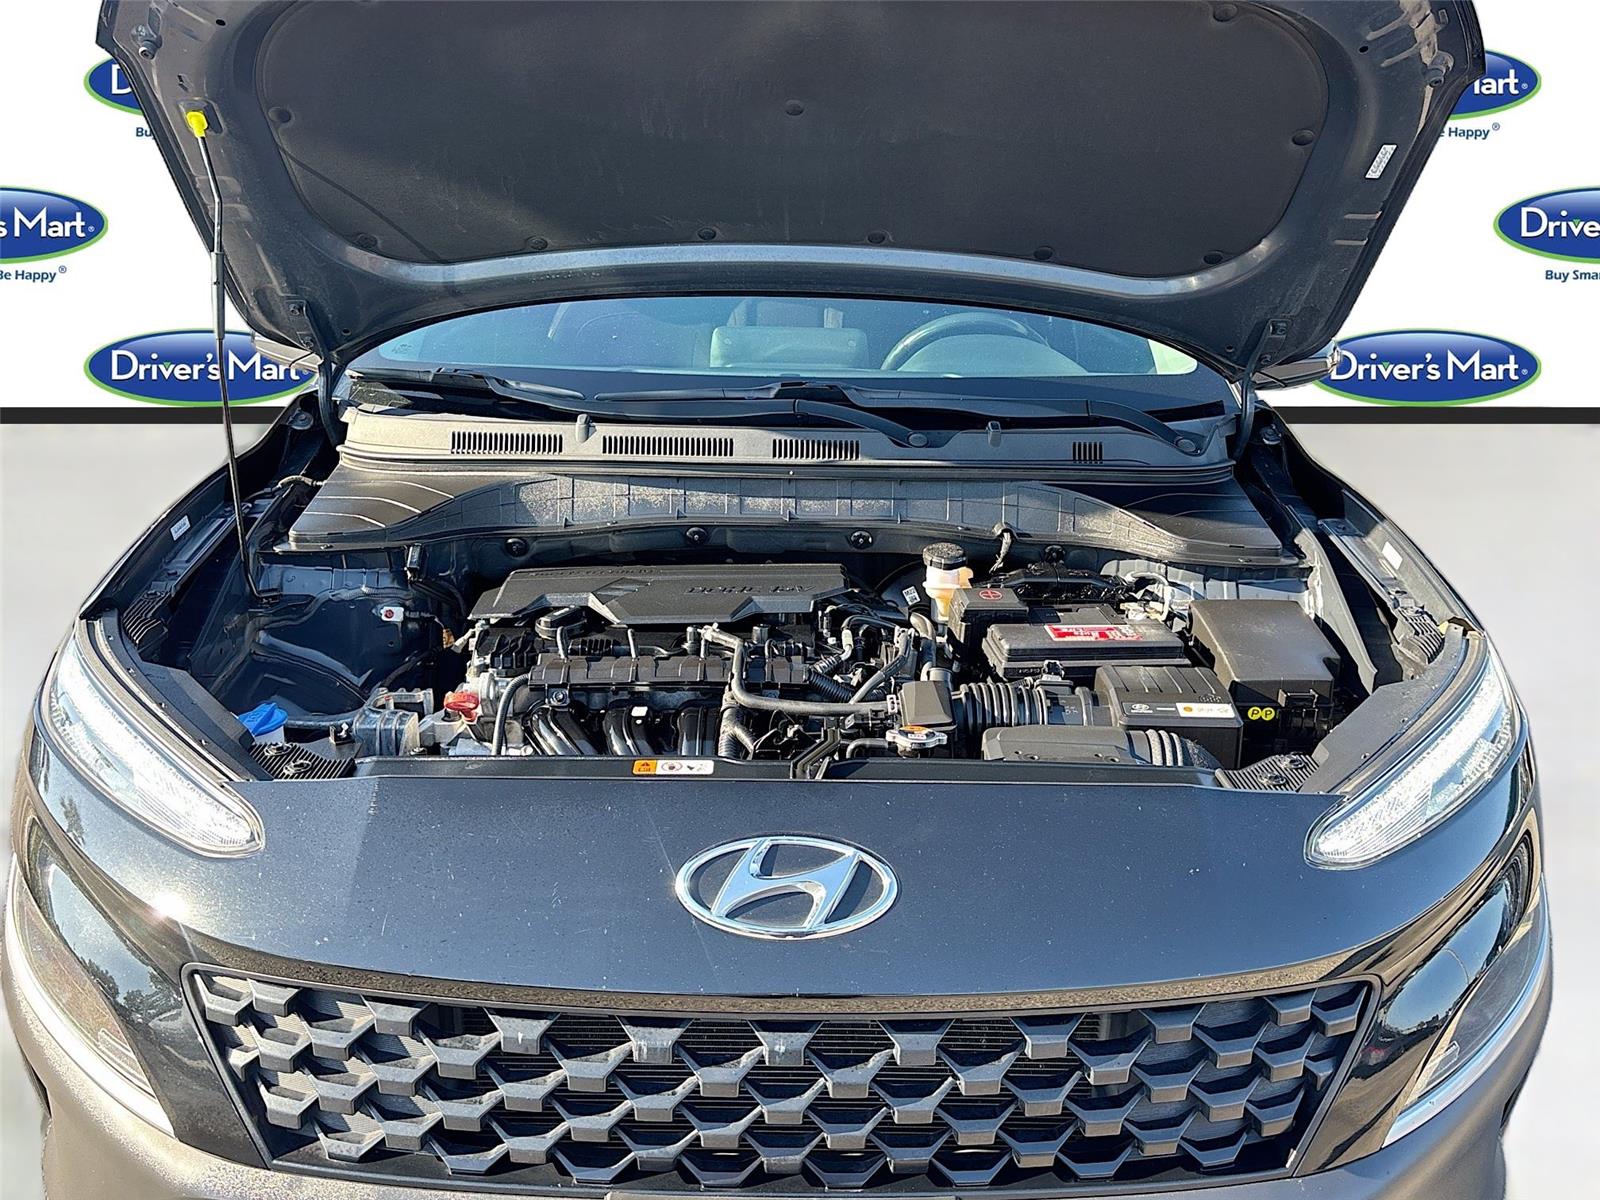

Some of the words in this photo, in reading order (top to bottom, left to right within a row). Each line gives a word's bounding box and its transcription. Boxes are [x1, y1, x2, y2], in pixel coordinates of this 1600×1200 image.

[136, 127, 155, 140] Bu
[1449, 127, 1490, 140] Happy
[14, 206, 86, 237] Mart
[1521, 206, 1600, 238] Drive
[15, 269, 57, 283] Happy
[1545, 269, 1570, 283] Buy
[1572, 269, 1600, 280] Sma
[111, 349, 220, 381] Driver's
[1330, 349, 1441, 381] Driver's
[1447, 349, 1519, 381] Mart
